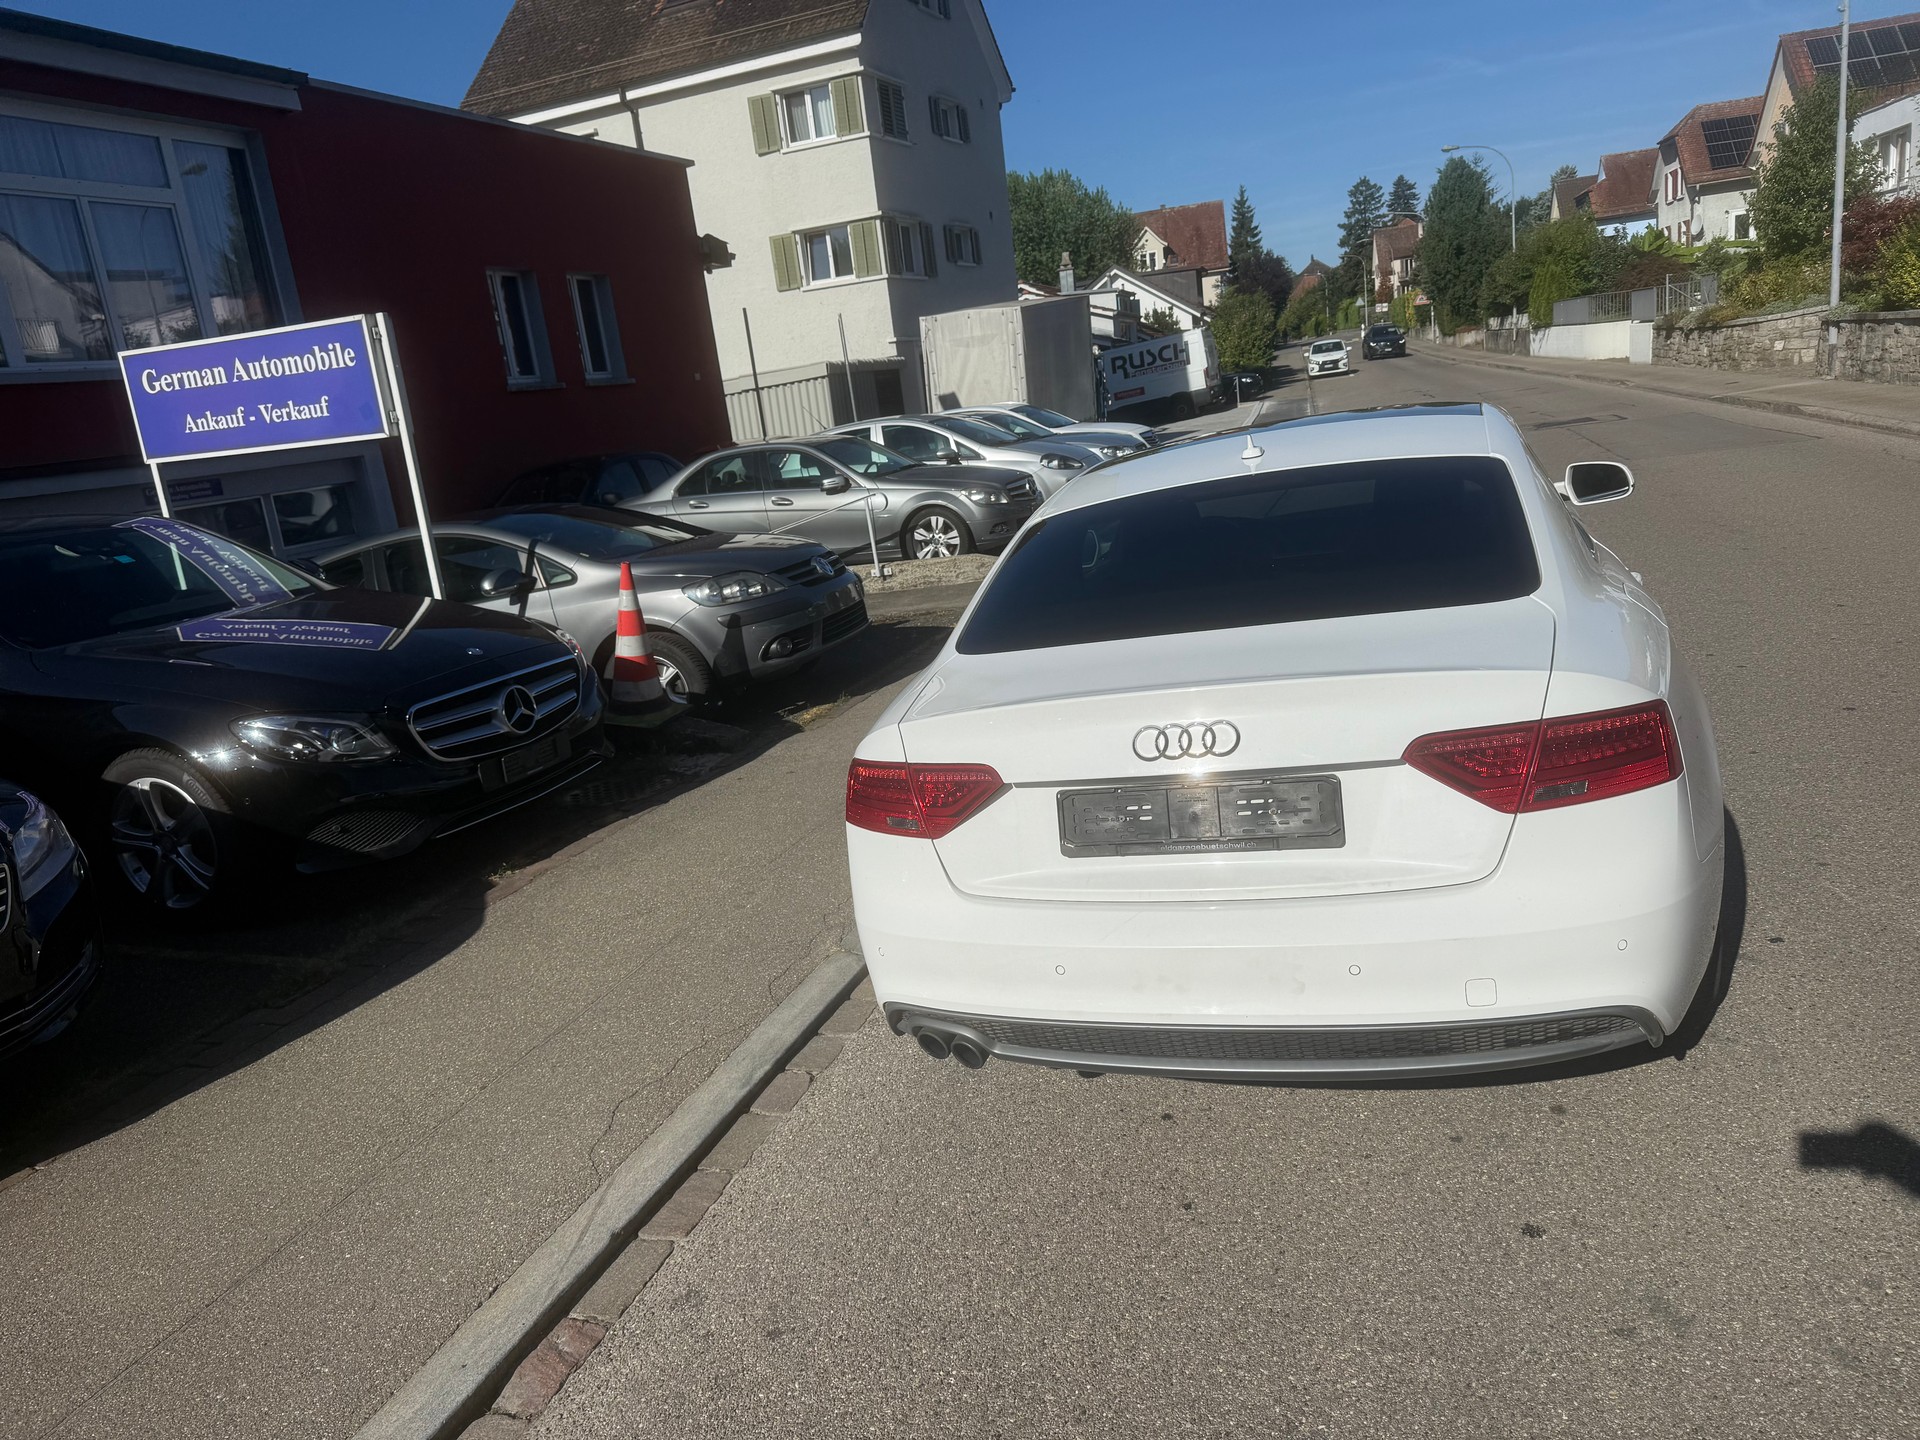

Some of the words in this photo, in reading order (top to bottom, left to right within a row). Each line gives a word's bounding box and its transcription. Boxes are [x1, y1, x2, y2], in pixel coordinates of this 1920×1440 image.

[141, 366, 228, 394] German
[232, 342, 357, 383] Automobile
[1111, 341, 1191, 379] RUSCH
[185, 407, 245, 433] Ankauf
[258, 396, 330, 424] Verkauf
